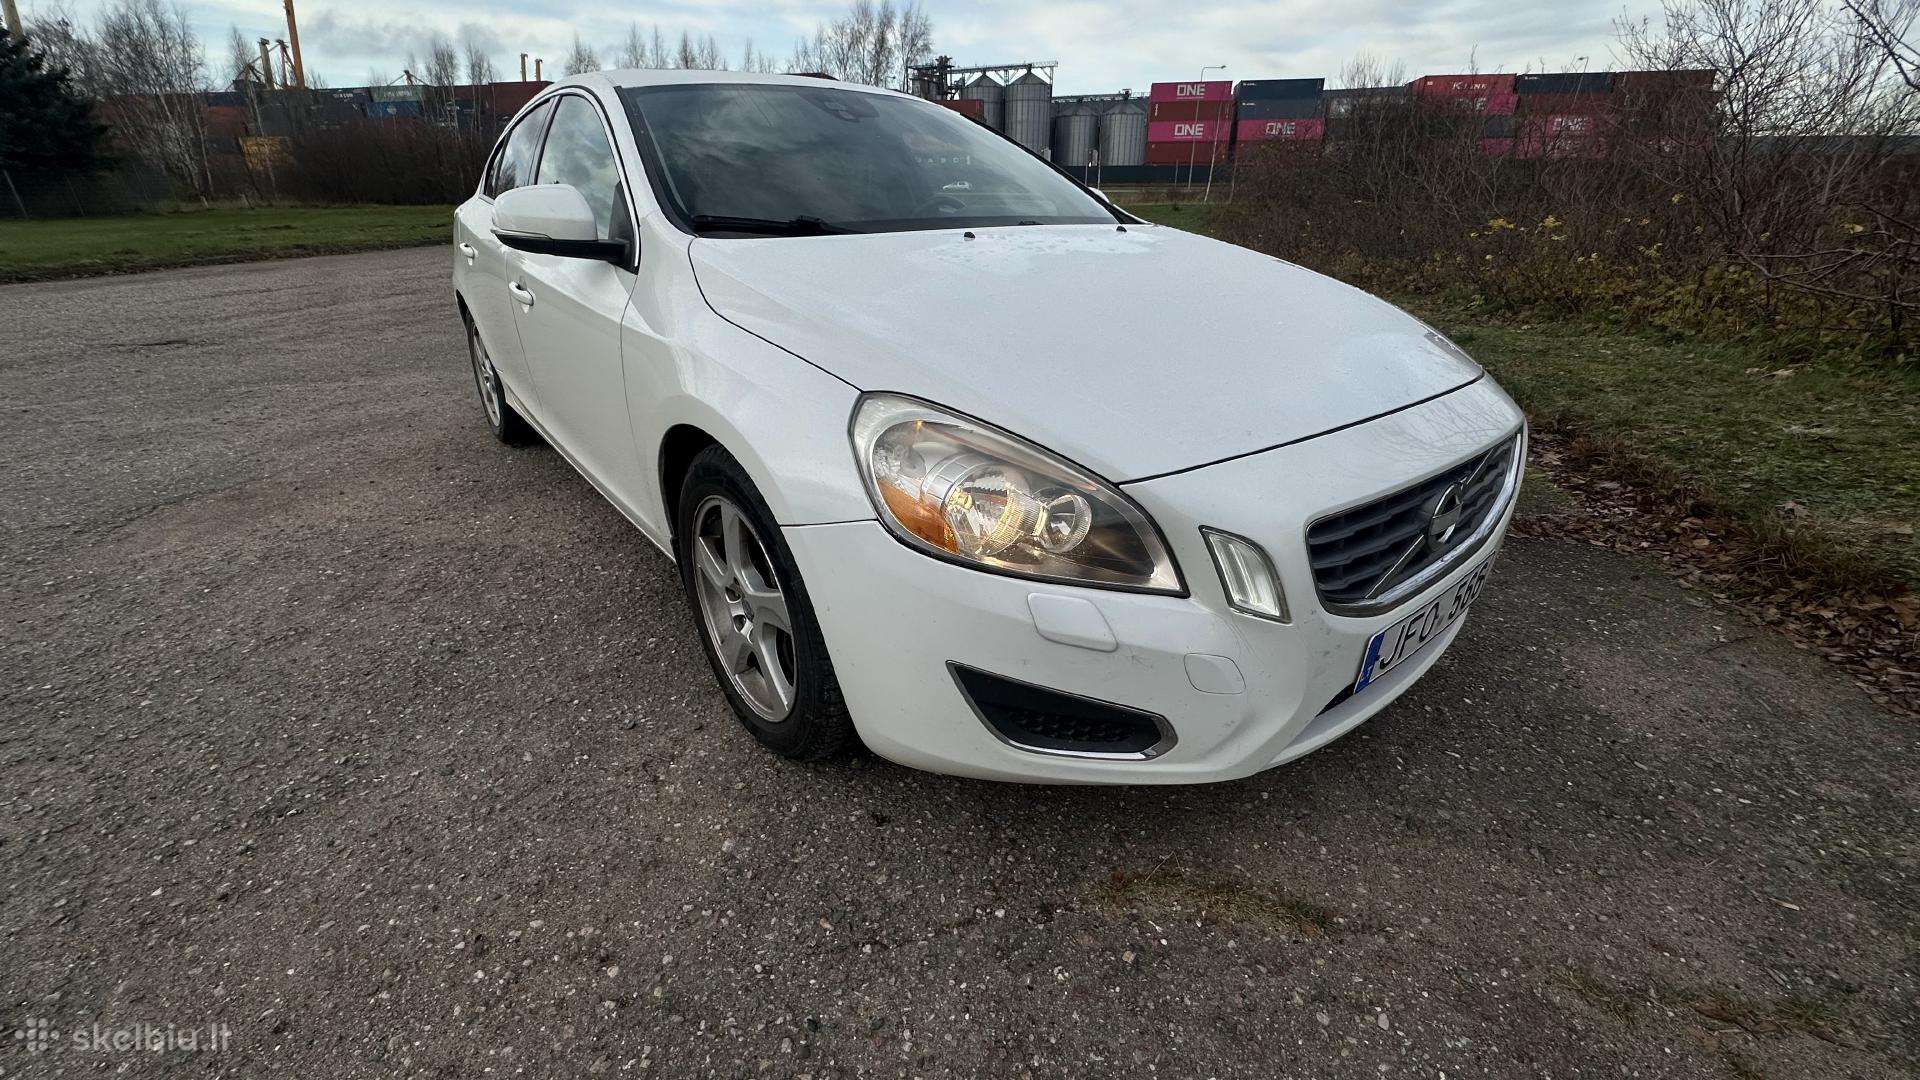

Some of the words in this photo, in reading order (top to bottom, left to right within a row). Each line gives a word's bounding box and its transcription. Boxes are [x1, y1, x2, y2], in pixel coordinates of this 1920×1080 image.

[1176, 83, 1206, 96] ONE
[1174, 123, 1204, 136] ONE
[1265, 122, 1296, 136] ONE
[1379, 601, 1441, 670] JFO
